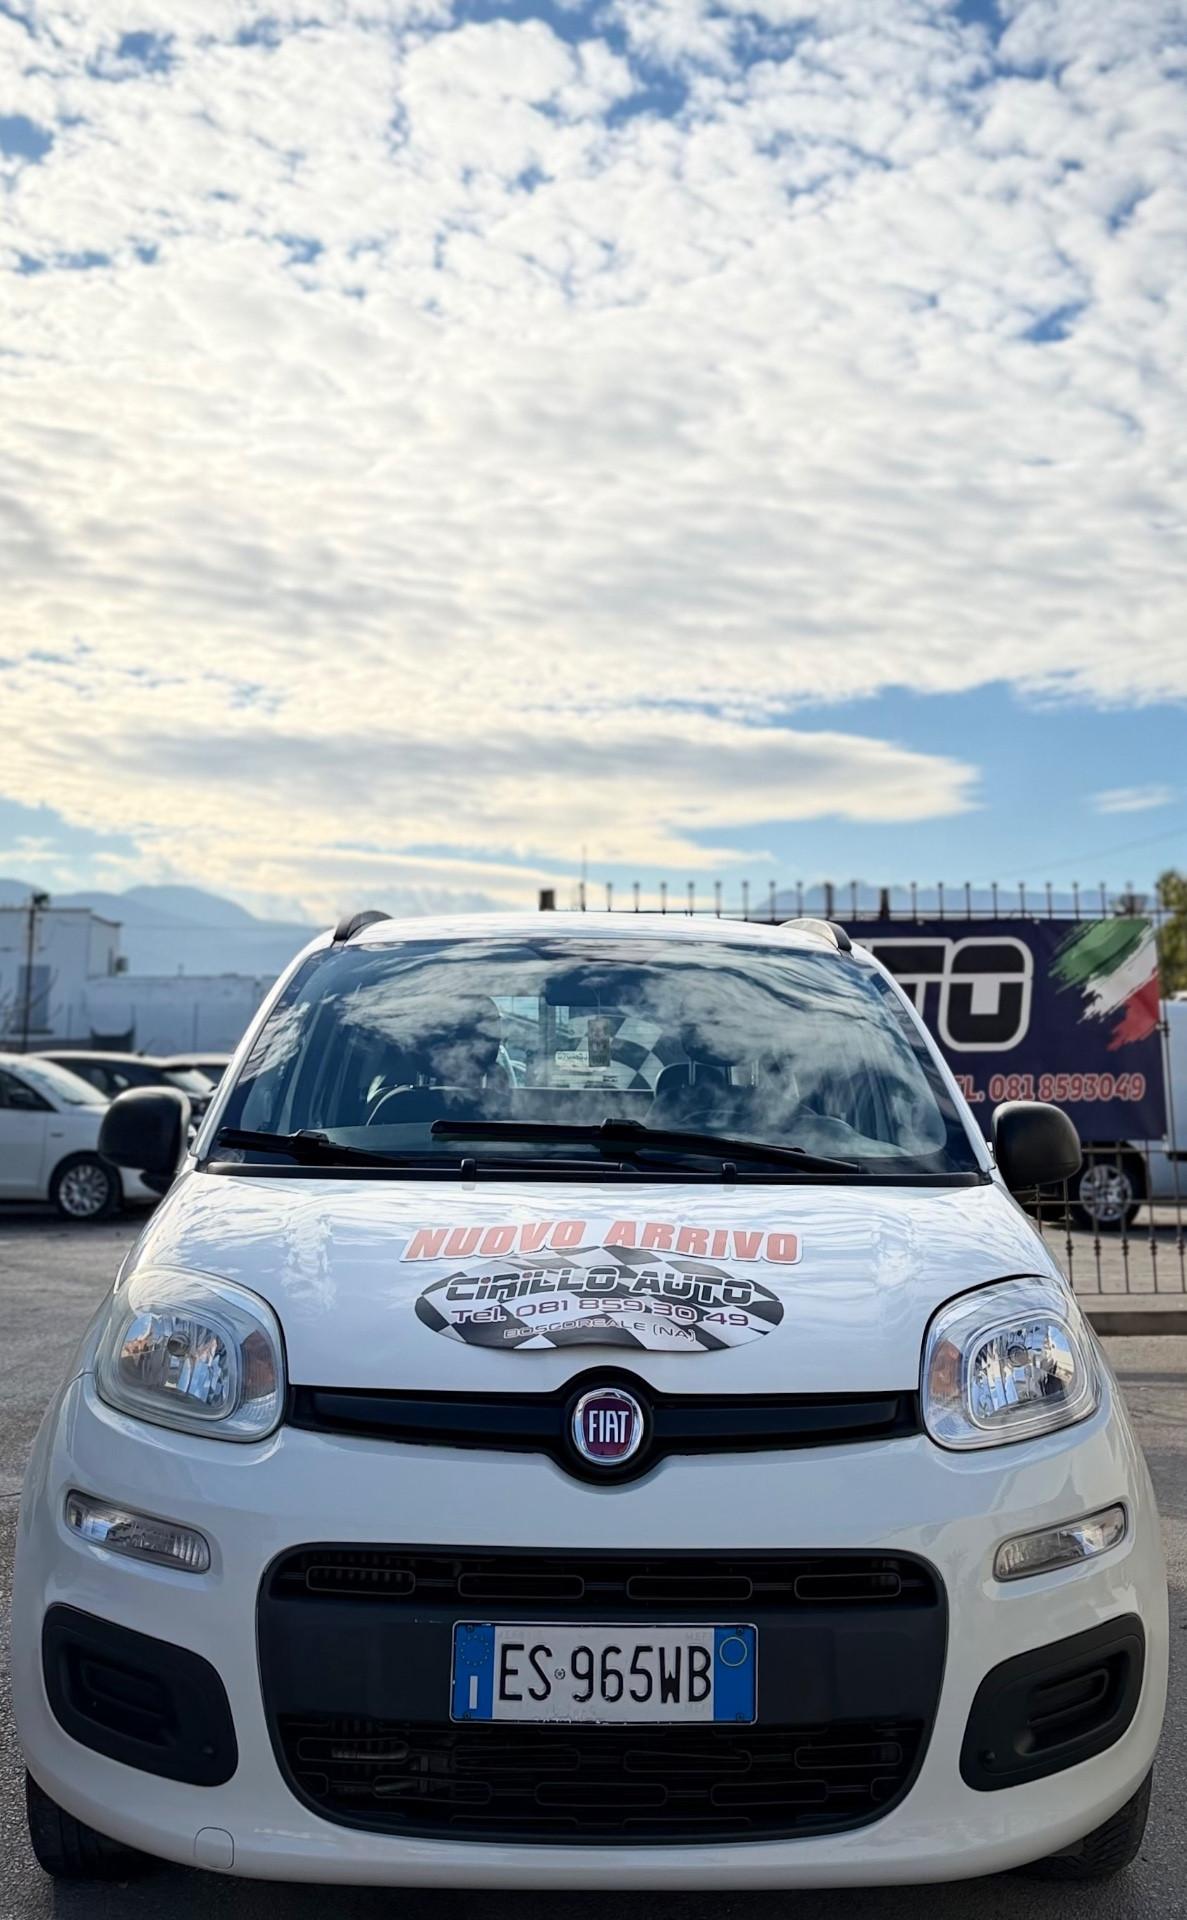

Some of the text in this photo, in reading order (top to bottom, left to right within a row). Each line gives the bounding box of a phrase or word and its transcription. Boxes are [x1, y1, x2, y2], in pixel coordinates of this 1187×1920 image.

[989, 1073, 1035, 1101] 081
[1038, 1072, 1146, 1101] 8593049
[402, 1219, 800, 1262] NUOVO ARRIVO
[629, 1270, 754, 1306] AUTO
[451, 1297, 749, 1326] Tel. 081 859 30 49
[503, 1318, 696, 1342] BOSCOREALE (NA)
[588, 1410, 629, 1443] FIAT
